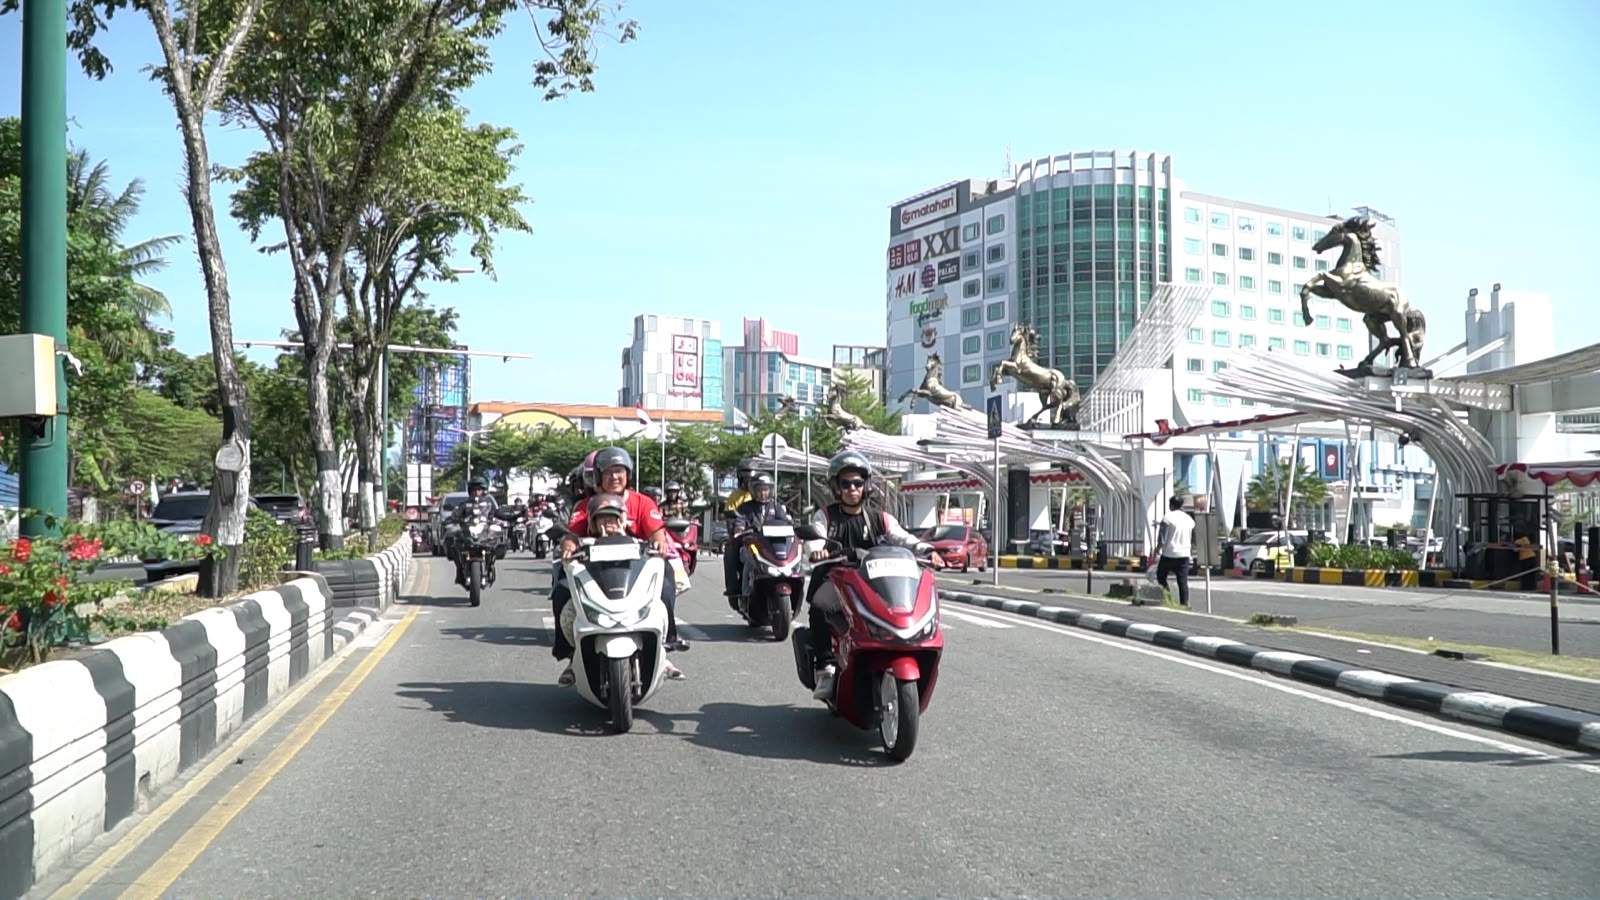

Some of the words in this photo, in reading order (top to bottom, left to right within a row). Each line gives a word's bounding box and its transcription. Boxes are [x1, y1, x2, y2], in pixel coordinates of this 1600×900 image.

[911, 194, 954, 220] matahari
[922, 226, 960, 260] XXI
[895, 271, 916, 298] H&M
